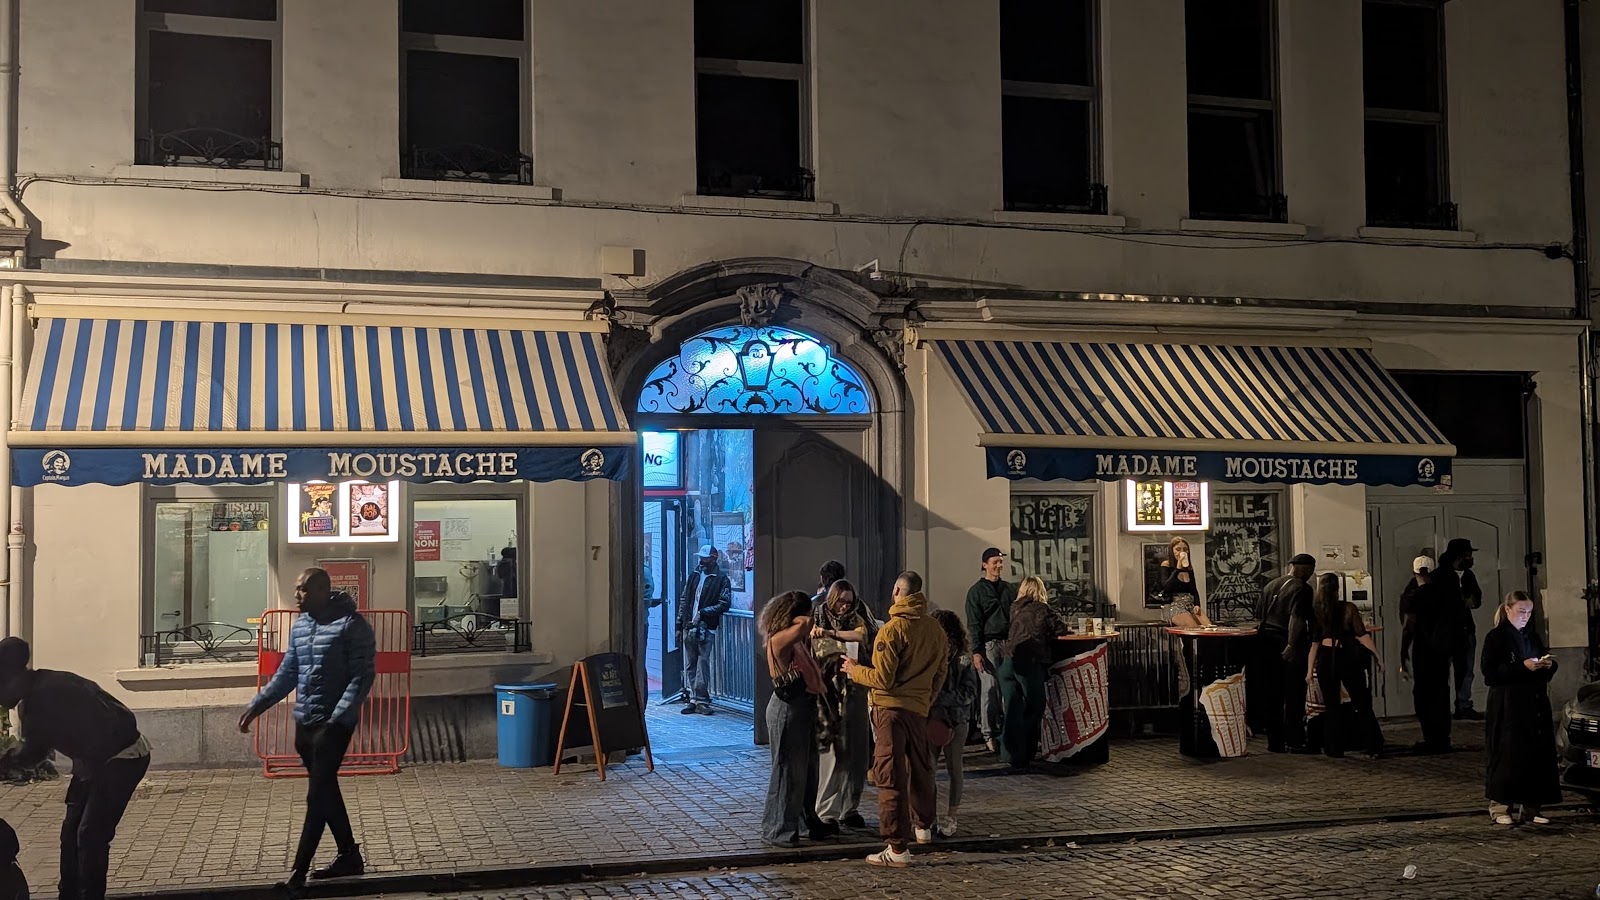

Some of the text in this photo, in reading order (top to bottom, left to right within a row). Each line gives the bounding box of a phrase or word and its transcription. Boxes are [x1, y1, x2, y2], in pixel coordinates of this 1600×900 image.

[142, 452, 518, 478] MADAME MOUSTACHE
[1096, 454, 1358, 480] MADAME MOUSTACHE
[592, 545, 601, 560] 7
[1010, 537, 1091, 583] SILENCE
[1352, 545, 1360, 558] 5
[1593, 754, 1599, 765] 2
